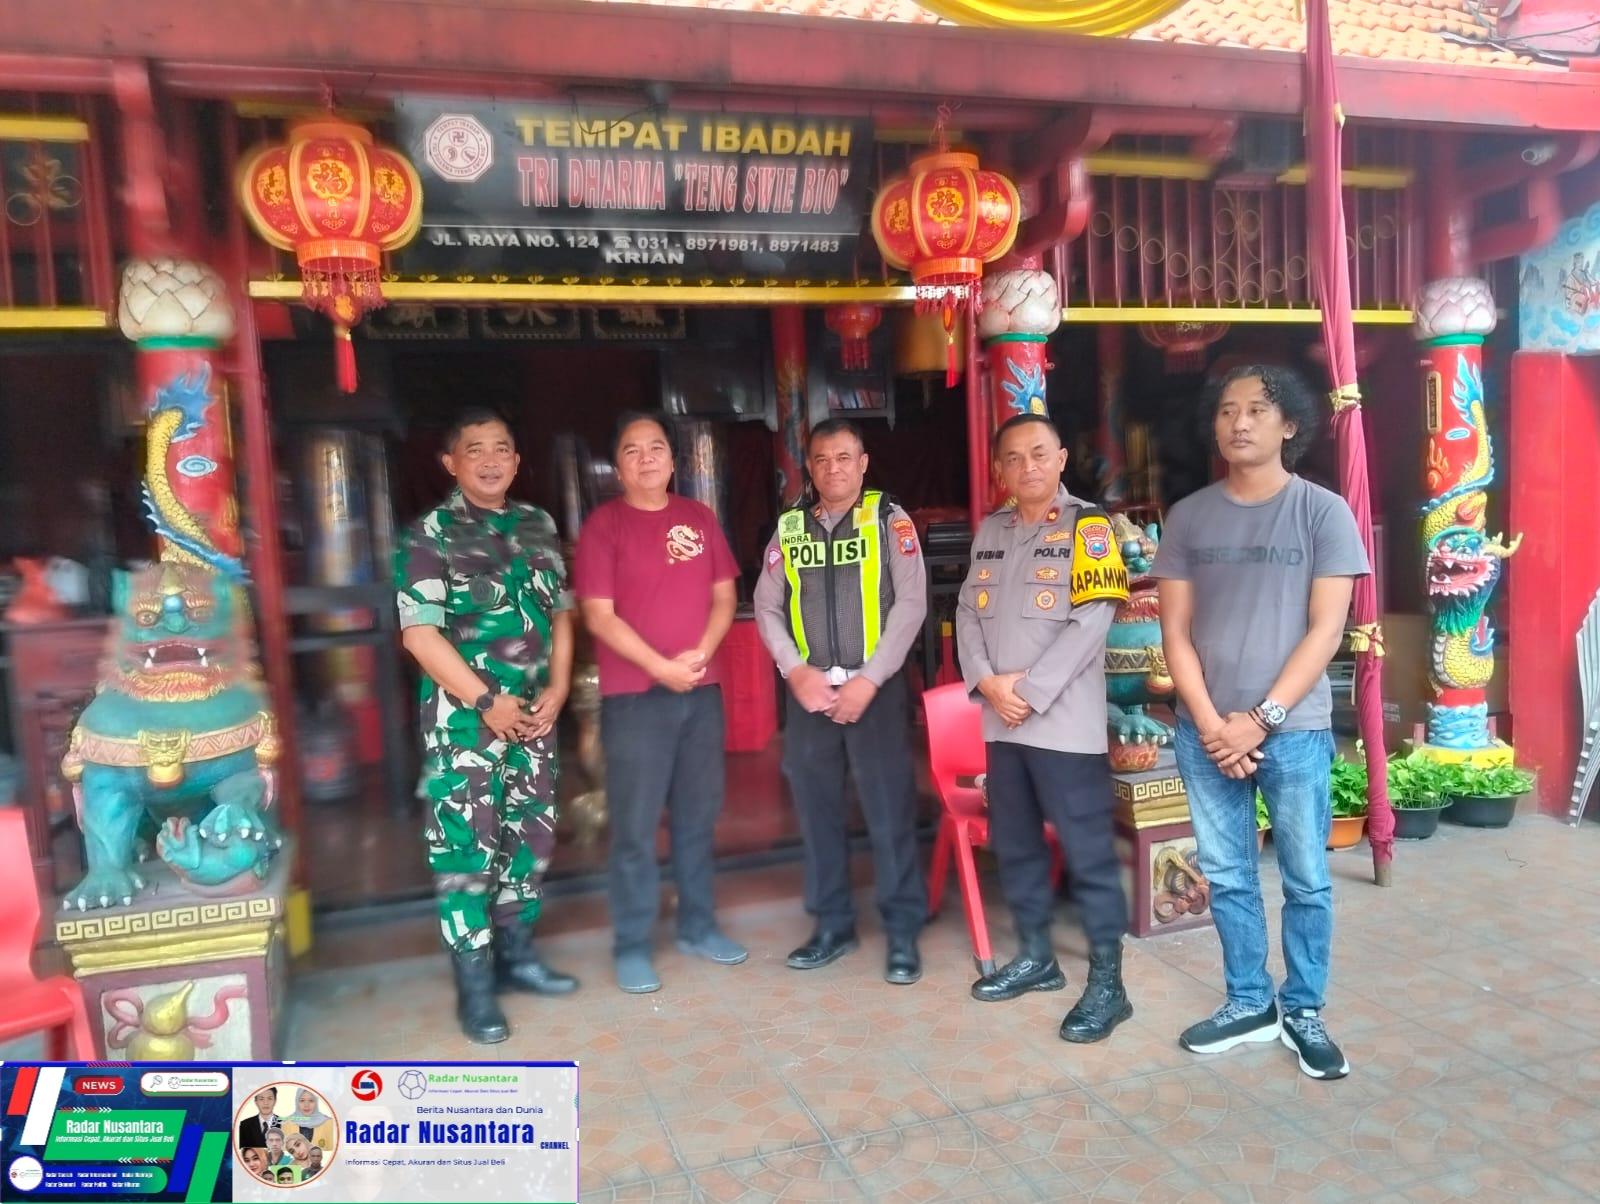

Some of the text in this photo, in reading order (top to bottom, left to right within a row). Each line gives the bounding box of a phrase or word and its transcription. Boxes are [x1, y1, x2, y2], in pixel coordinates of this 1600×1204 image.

[516, 119, 852, 157] TEMPAT IBADAH
[517, 157, 559, 208] TRI
[568, 159, 665, 210] DHARMA
[742, 164, 795, 214] SWIE
[432, 233, 462, 247] JL.
[468, 233, 521, 248] RAYA
[526, 234, 560, 249] NO.
[566, 235, 600, 250] 124
[637, 237, 670, 251] 031
[686, 238, 764, 254] 8971981,
[769, 239, 840, 254] 8971483
[605, 251, 685, 265] KRIAN
[781, 535, 810, 545] INDRA
[1033, 547, 1071, 559] POLRI
